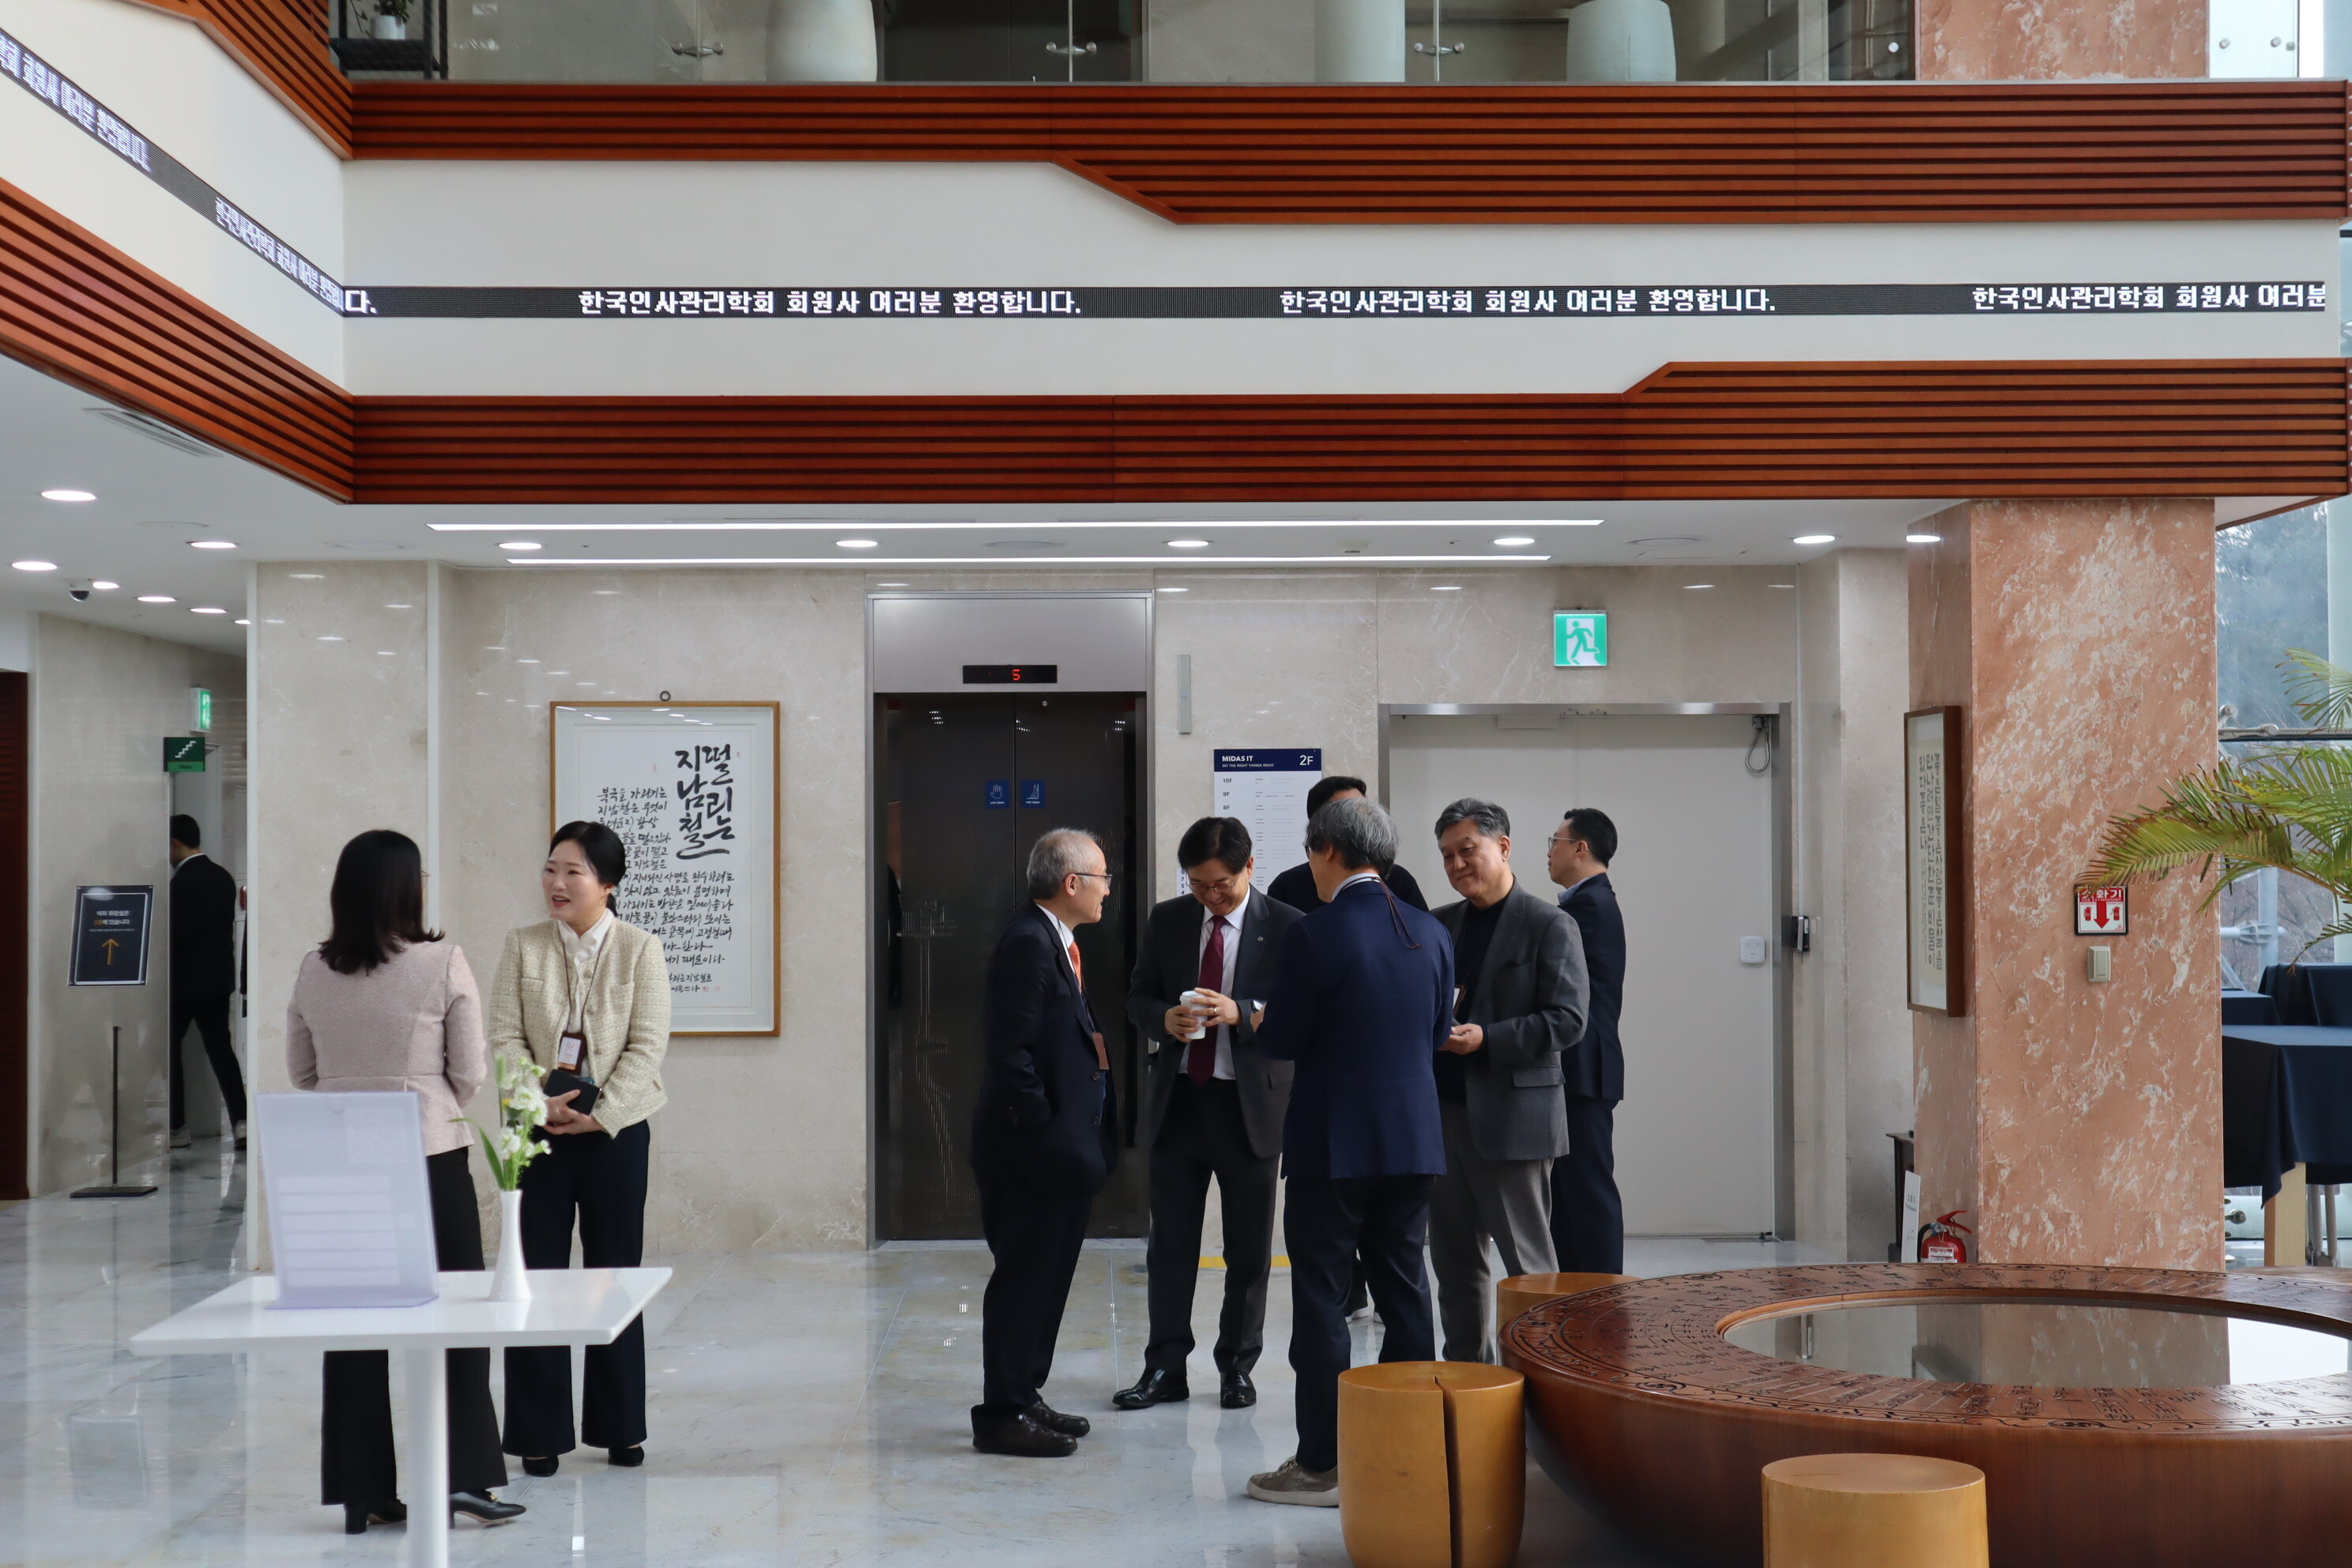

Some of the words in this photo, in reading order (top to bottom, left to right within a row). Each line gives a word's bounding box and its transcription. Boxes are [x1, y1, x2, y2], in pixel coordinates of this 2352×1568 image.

[578, 290, 774, 315] 한국인사관리학회
[786, 290, 860, 314] 회원사
[869, 290, 941, 314] 여러분
[952, 290, 1081, 315] 환영합니다.
[1280, 290, 1472, 314] 한국인사관리학회
[1484, 289, 1557, 313] 회원사
[1566, 289, 1637, 312] 여러분
[1649, 288, 1776, 313] 환영합니다.
[1972, 285, 2164, 310] 한국인사관리학회
[2175, 285, 2249, 309] 회원사
[2259, 284, 2326, 308] 여러분
[1012, 669, 1020, 680] 5
[1299, 755, 1314, 766] 2F
[674, 745, 729, 860] 지남철
[702, 744, 735, 840] 떨리는
[642, 801, 667, 816] 무엇이
